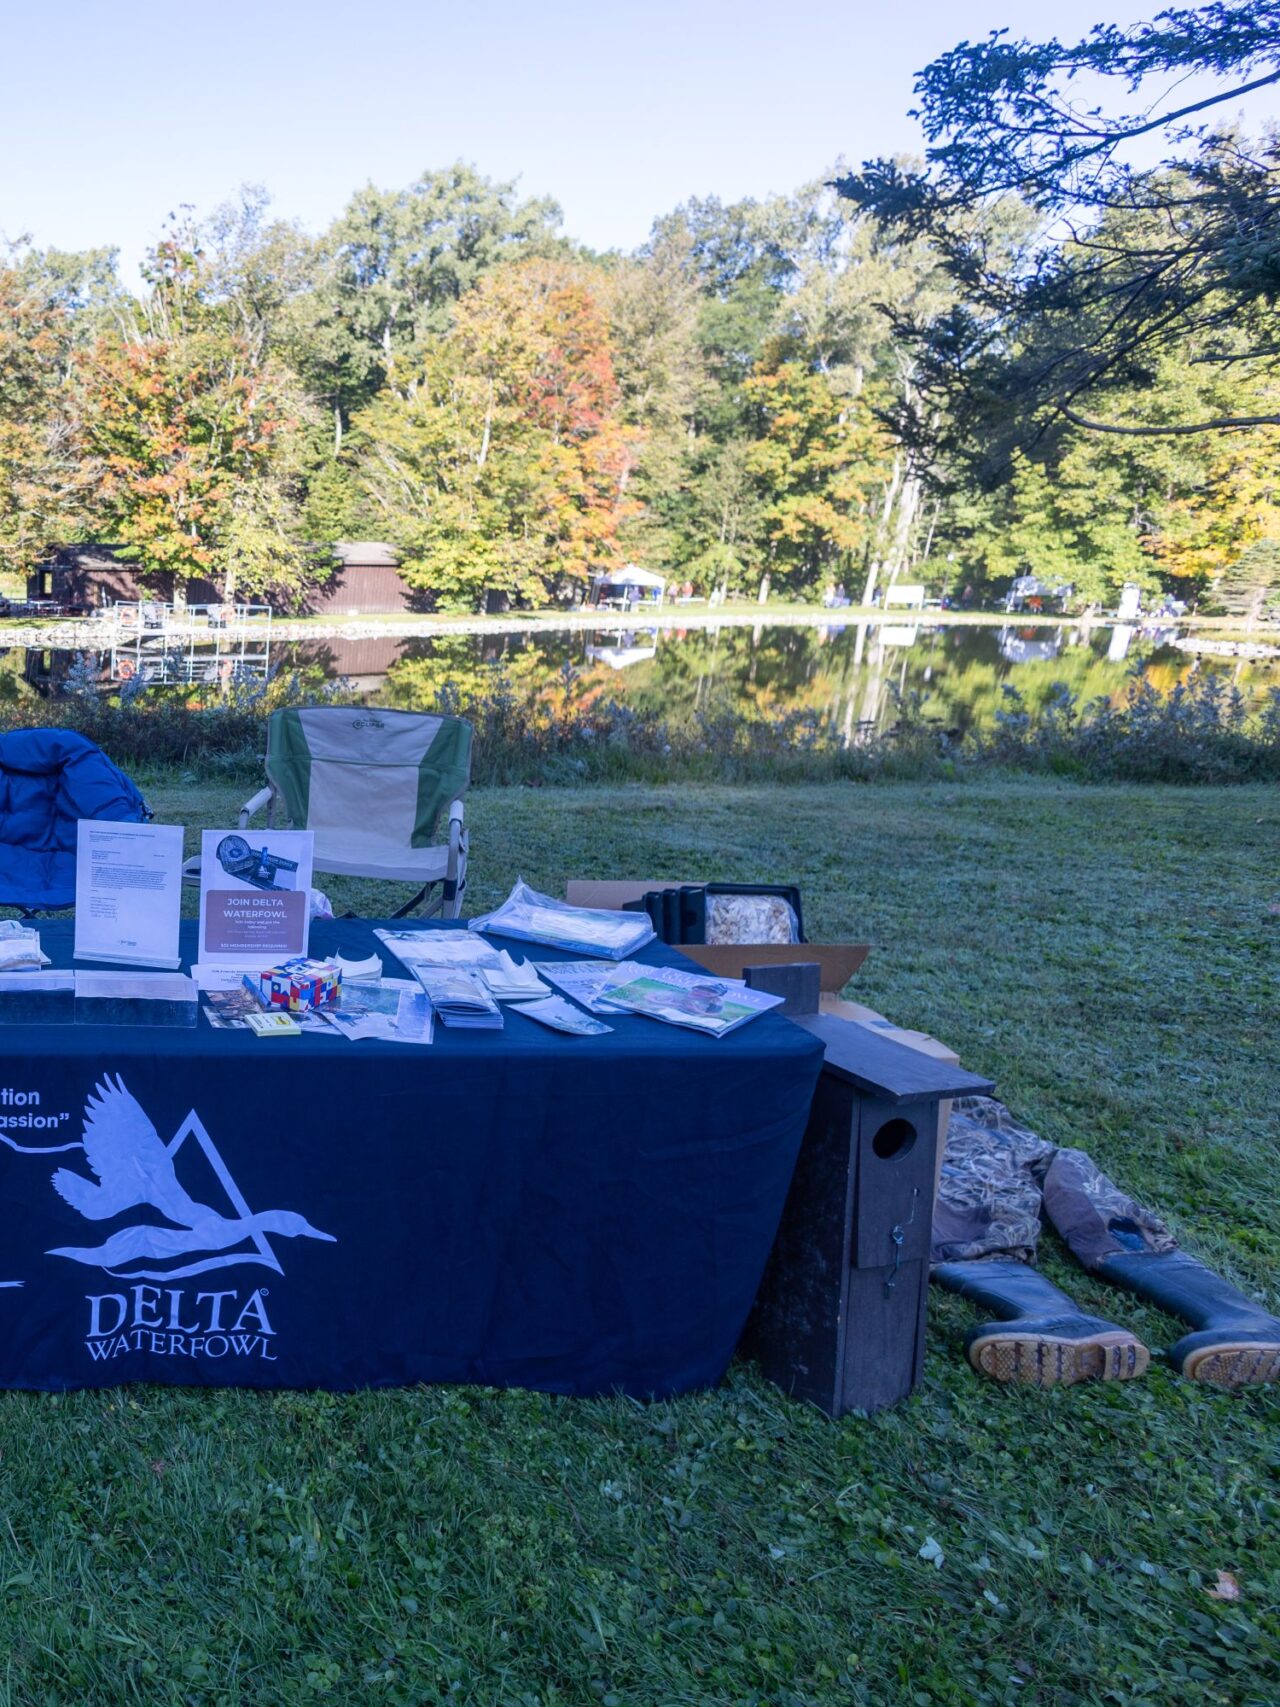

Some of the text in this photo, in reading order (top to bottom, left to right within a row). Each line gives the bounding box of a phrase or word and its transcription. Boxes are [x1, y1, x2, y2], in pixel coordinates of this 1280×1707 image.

[227, 898, 284, 907] JOIN DELTA
[223, 910, 288, 918] WATERFOWL
[85, 1284, 277, 1337] DELTA
[84, 1329, 278, 1361] WATERFOWL
